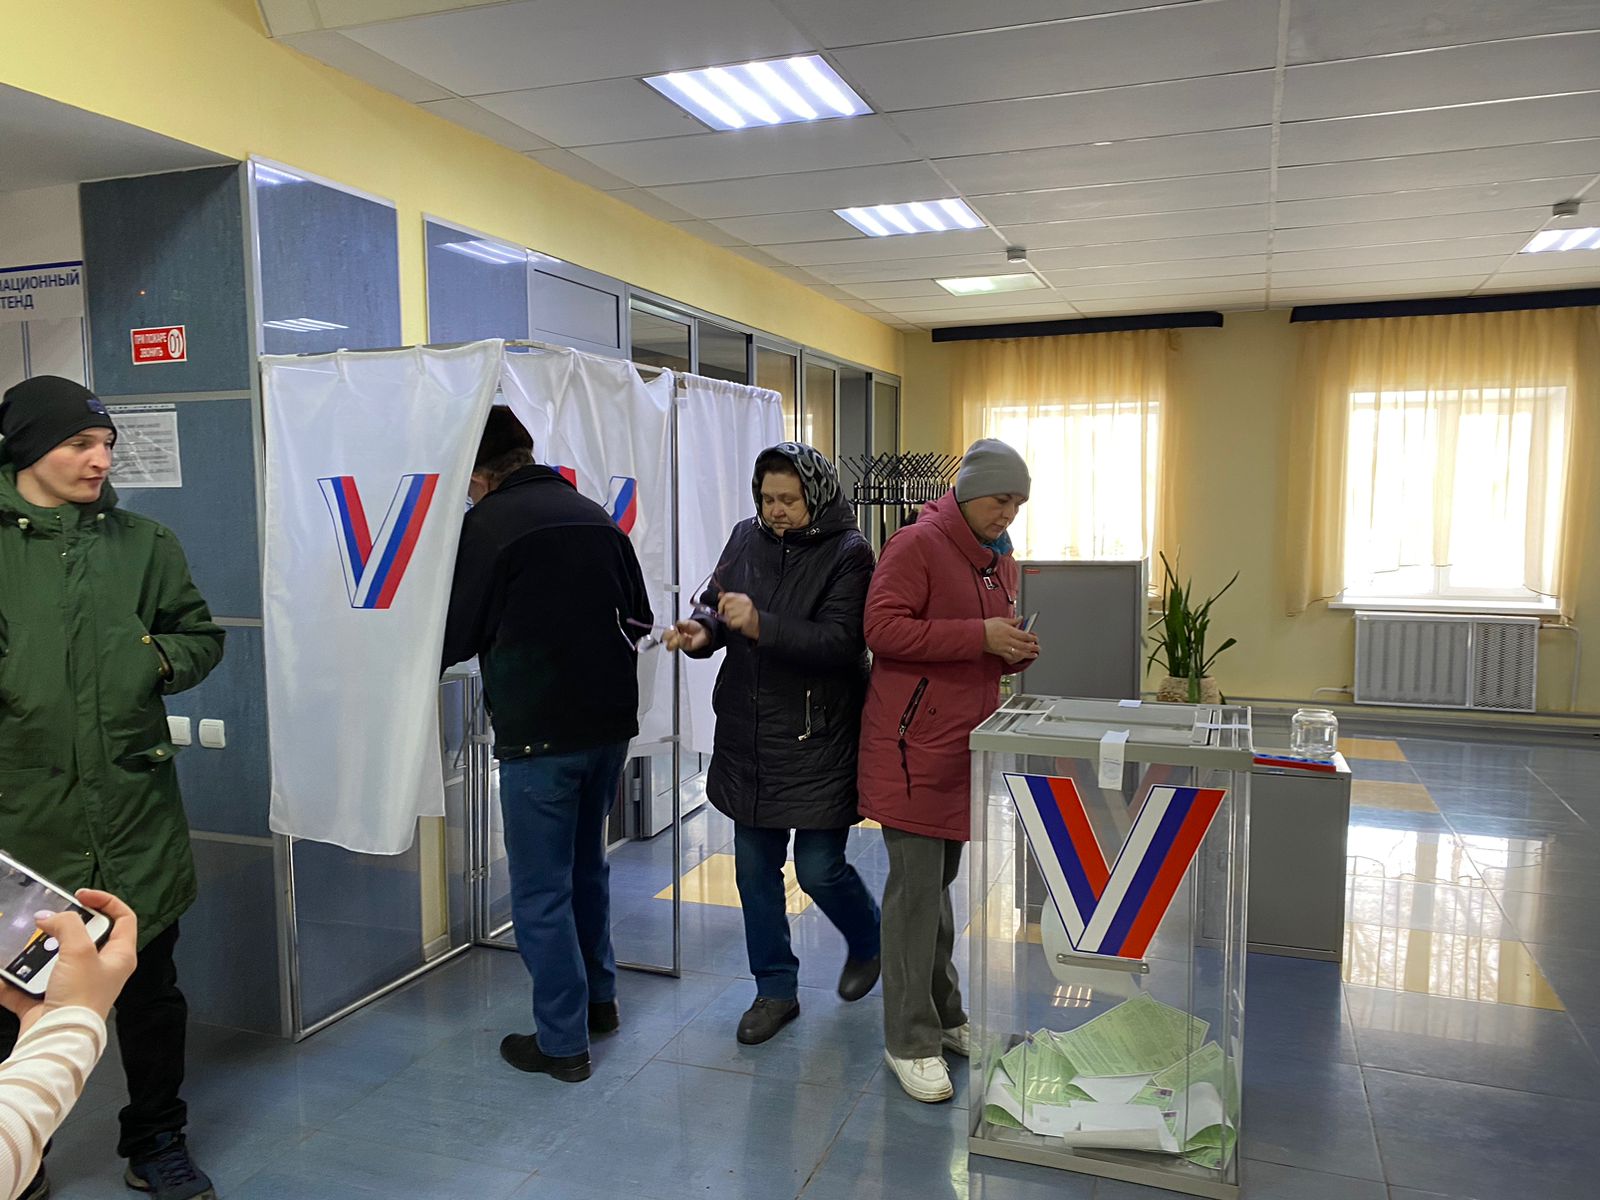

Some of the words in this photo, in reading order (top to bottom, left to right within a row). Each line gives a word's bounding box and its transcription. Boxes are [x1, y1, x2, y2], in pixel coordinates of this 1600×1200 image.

[0, 295, 34, 310] ТЕНД
[317, 473, 440, 609] V
[1001, 771, 1230, 961] V
